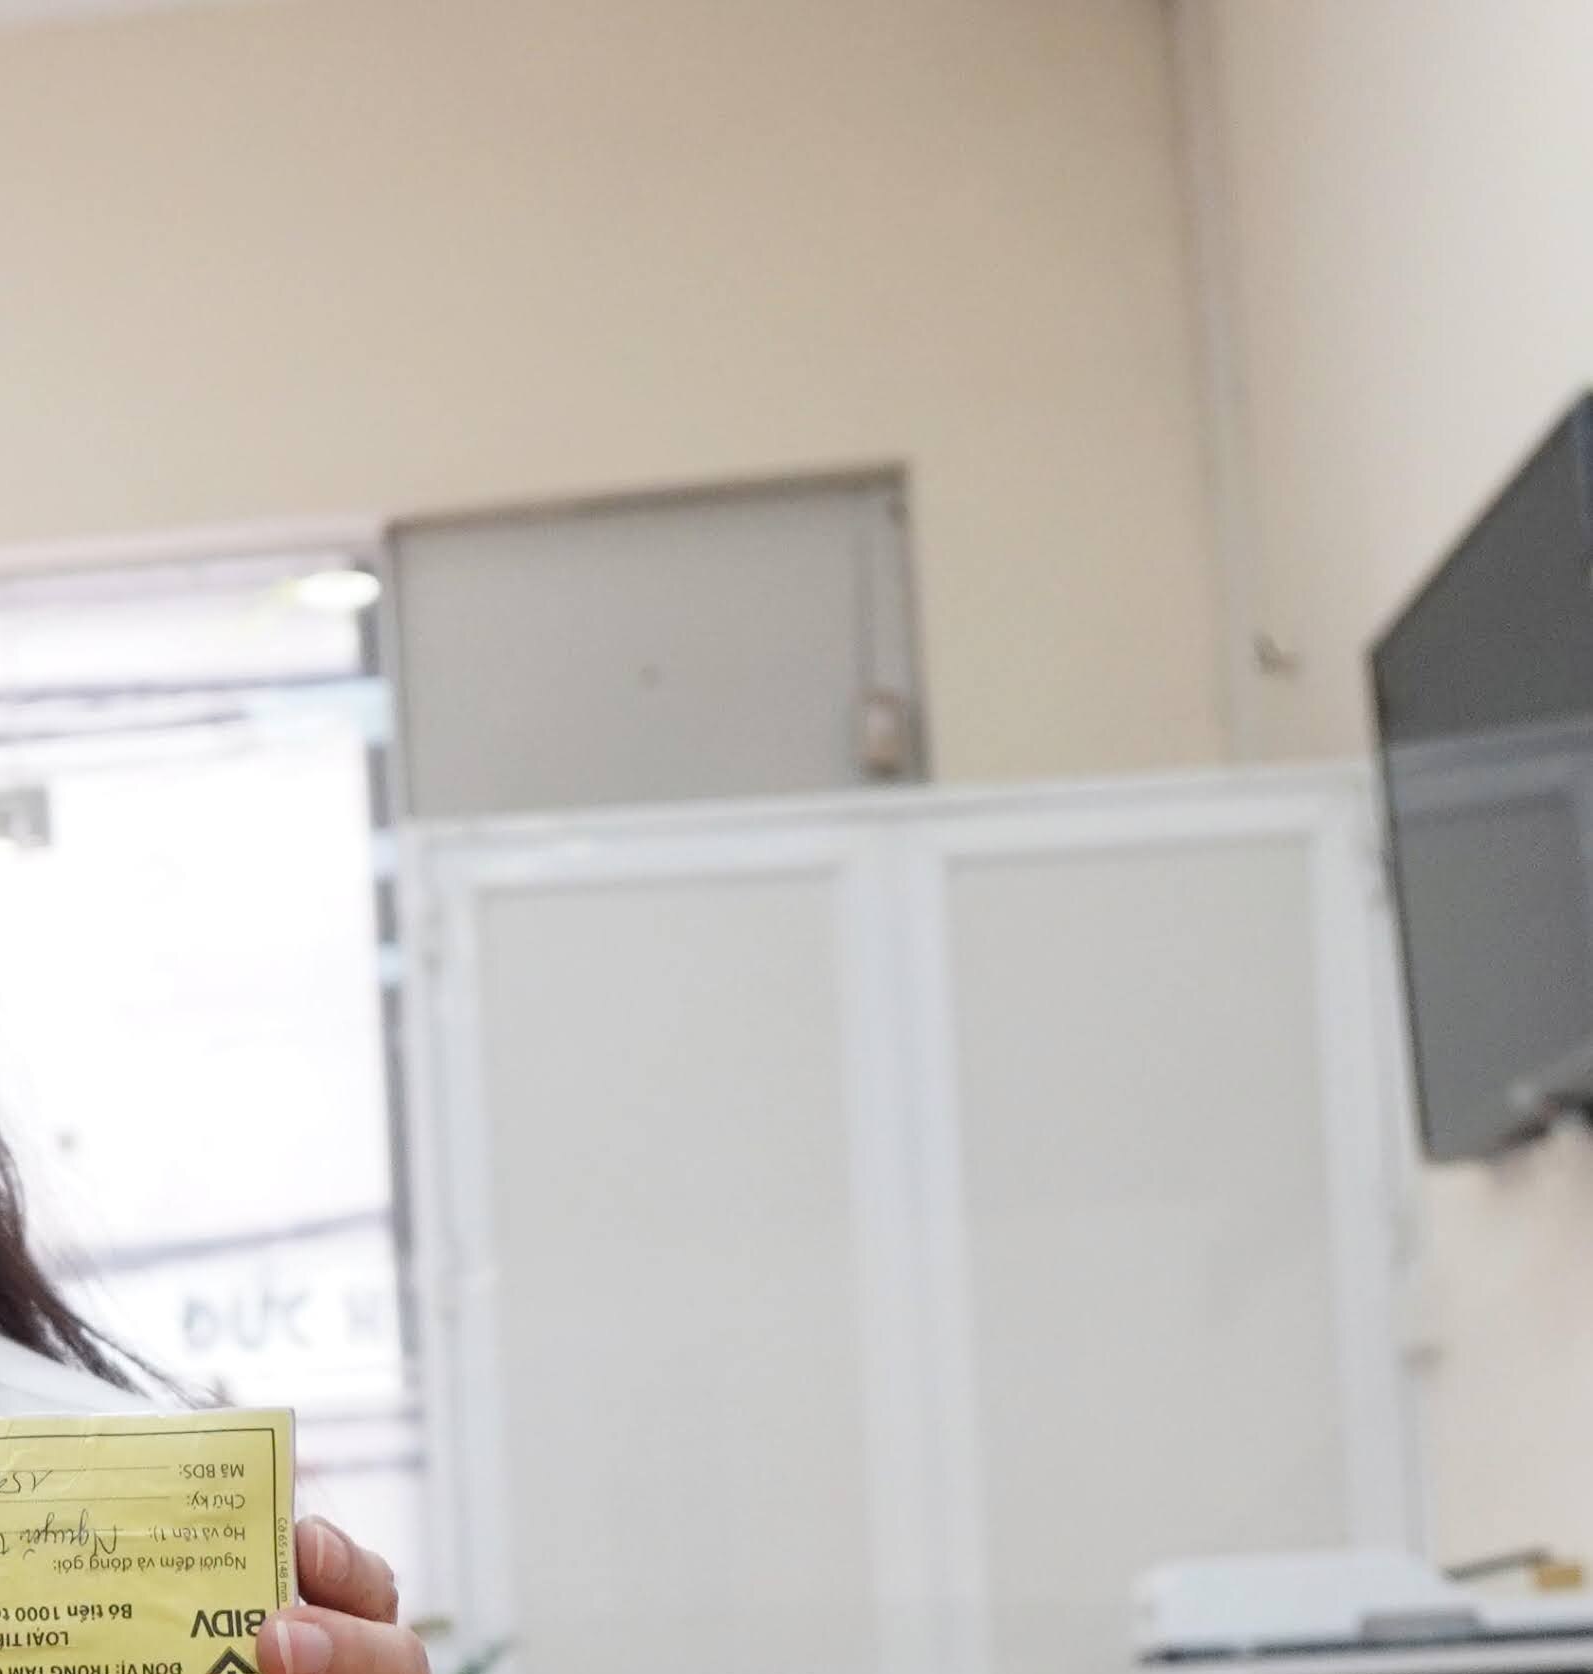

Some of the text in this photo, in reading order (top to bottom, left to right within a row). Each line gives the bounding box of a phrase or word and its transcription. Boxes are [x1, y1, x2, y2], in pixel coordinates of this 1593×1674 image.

[178, 1463, 244, 1479] Mã BDS:
[186, 1491, 246, 1510] Chữ ký:
[172, 1527, 197, 1542] tên
[202, 1527, 219, 1540] và
[223, 1523, 245, 1541] Họ
[278, 1534, 287, 1549] 65
[52, 1551, 246, 1574] Người đếm và đóng gói:
[280, 1582, 287, 1602] mm
[15, 1606, 60, 1622] 1000
[67, 1604, 103, 1623] tiền
[109, 1604, 132, 1621] Bó
[190, 1609, 266, 1639] BIDV
[27, 1627, 69, 1647] LOẠI
